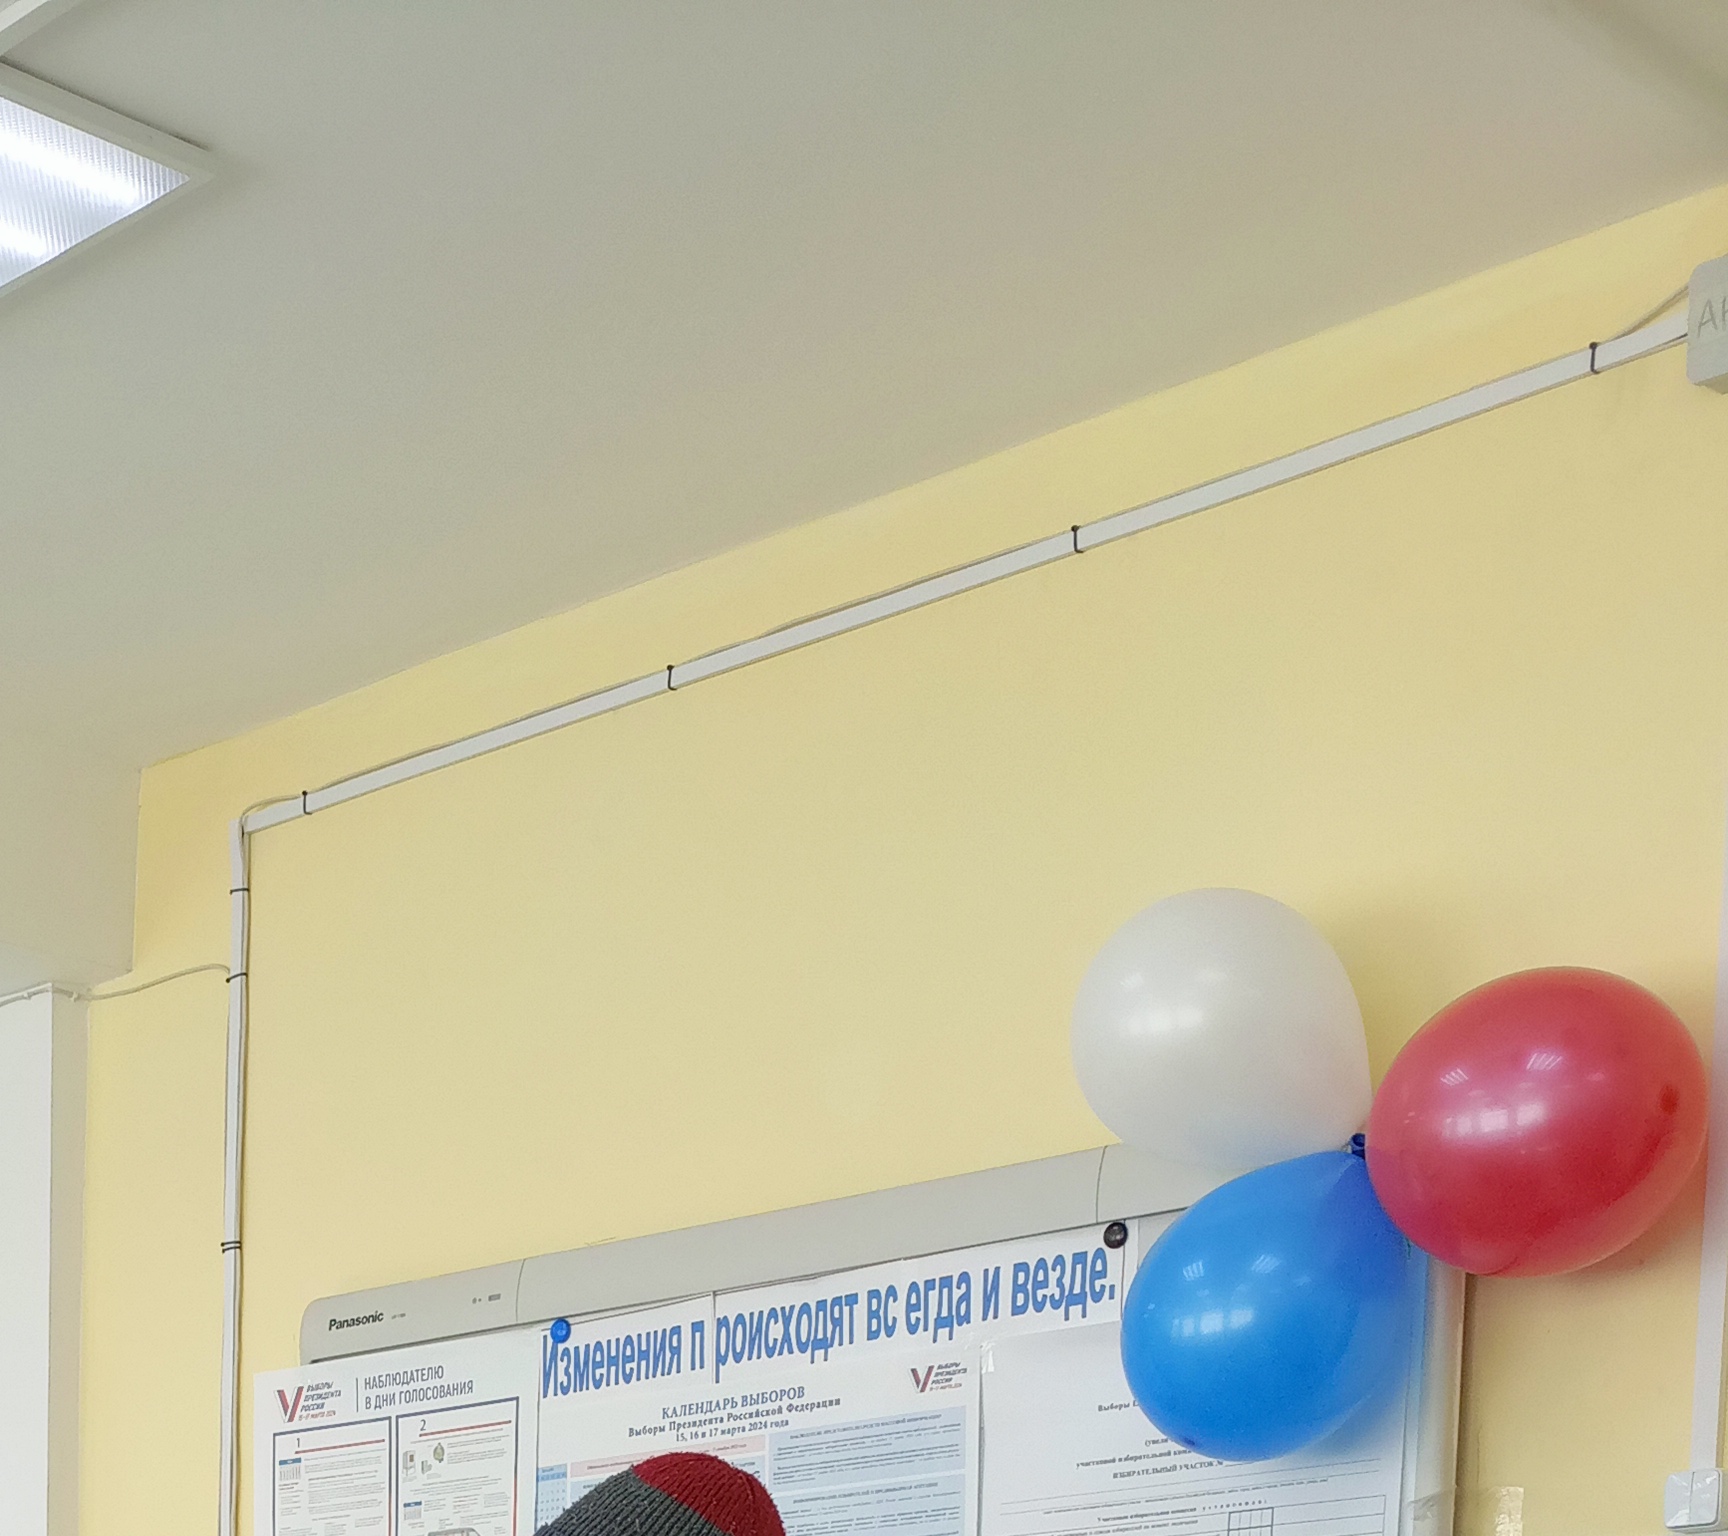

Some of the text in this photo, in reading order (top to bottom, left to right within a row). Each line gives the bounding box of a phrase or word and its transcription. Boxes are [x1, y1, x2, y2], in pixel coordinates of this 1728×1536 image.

[329, 1311, 384, 1331] Panasonic
[542, 1247, 1116, 1399] Изменения п роисходят вс егда и везде.
[365, 1365, 444, 1391] НАБЛЮДАТЕЛЮ
[365, 1380, 473, 1410] В ДНИ ГОЛОСОВАНИЯ
[662, 1386, 805, 1420] КАЛЕНДАРЬ ВЫБОРОВ
[420, 1419, 426, 1431] 2
[628, 1398, 841, 1438] Выборы Президента Российской Федерации
[676, 1432, 686, 1442] 15,
[690, 1430, 699, 1440] 16
[709, 1427, 718, 1437] 17
[721, 1425, 746, 1436] марта
[748, 1420, 767, 1432] 2024
[770, 1419, 789, 1430] года
